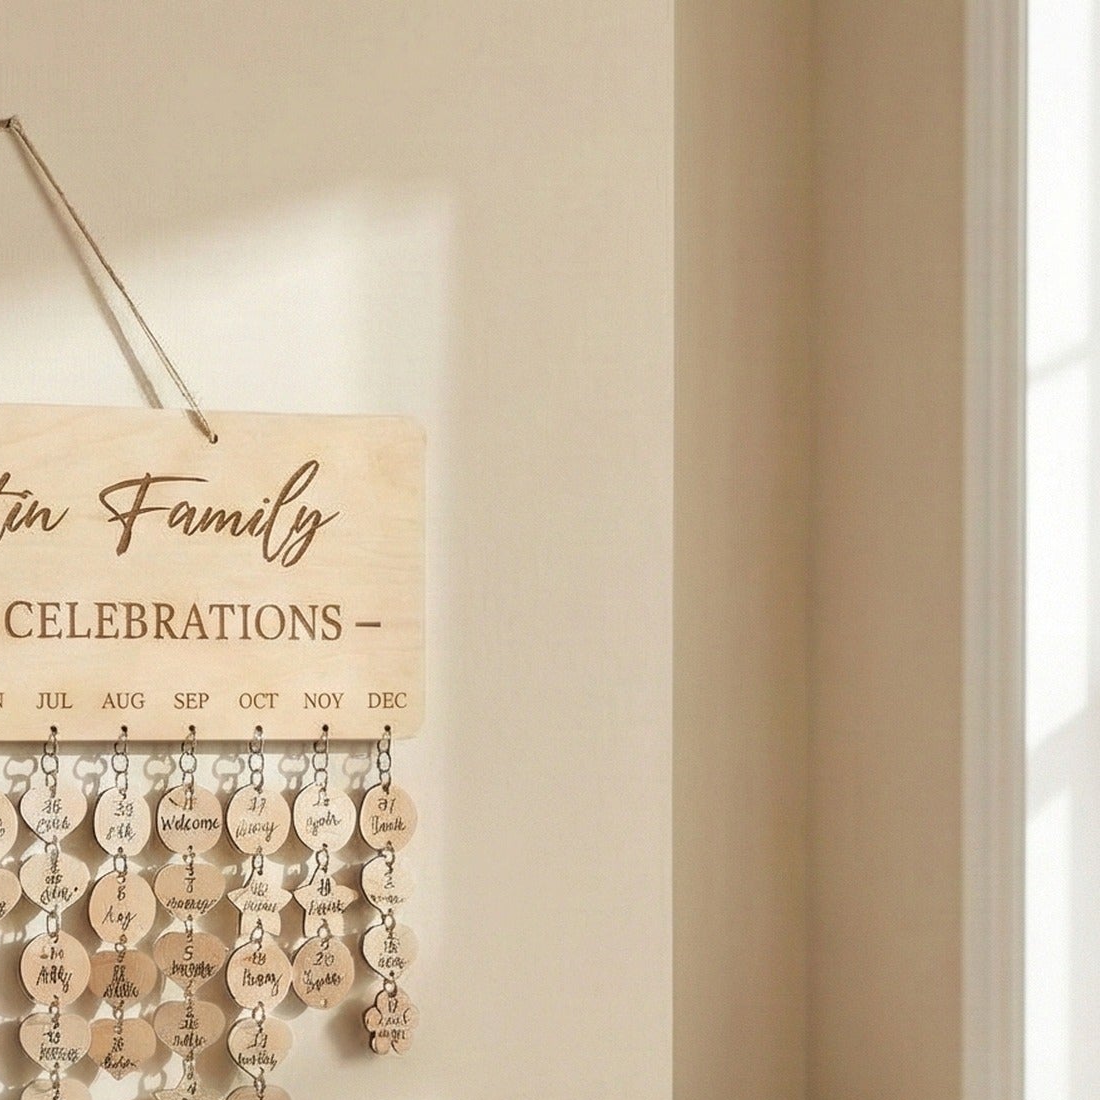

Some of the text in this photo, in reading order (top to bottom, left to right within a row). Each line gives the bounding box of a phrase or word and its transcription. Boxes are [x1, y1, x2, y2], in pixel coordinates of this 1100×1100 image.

[98, 459, 341, 569] Family
[4, 600, 343, 642] CELEBRATIONS
[35, 692, 75, 710] JUL
[101, 692, 147, 710] AUG
[173, 692, 211, 710] SEP
[238, 692, 280, 710] OCT
[367, 692, 408, 710] DEC
